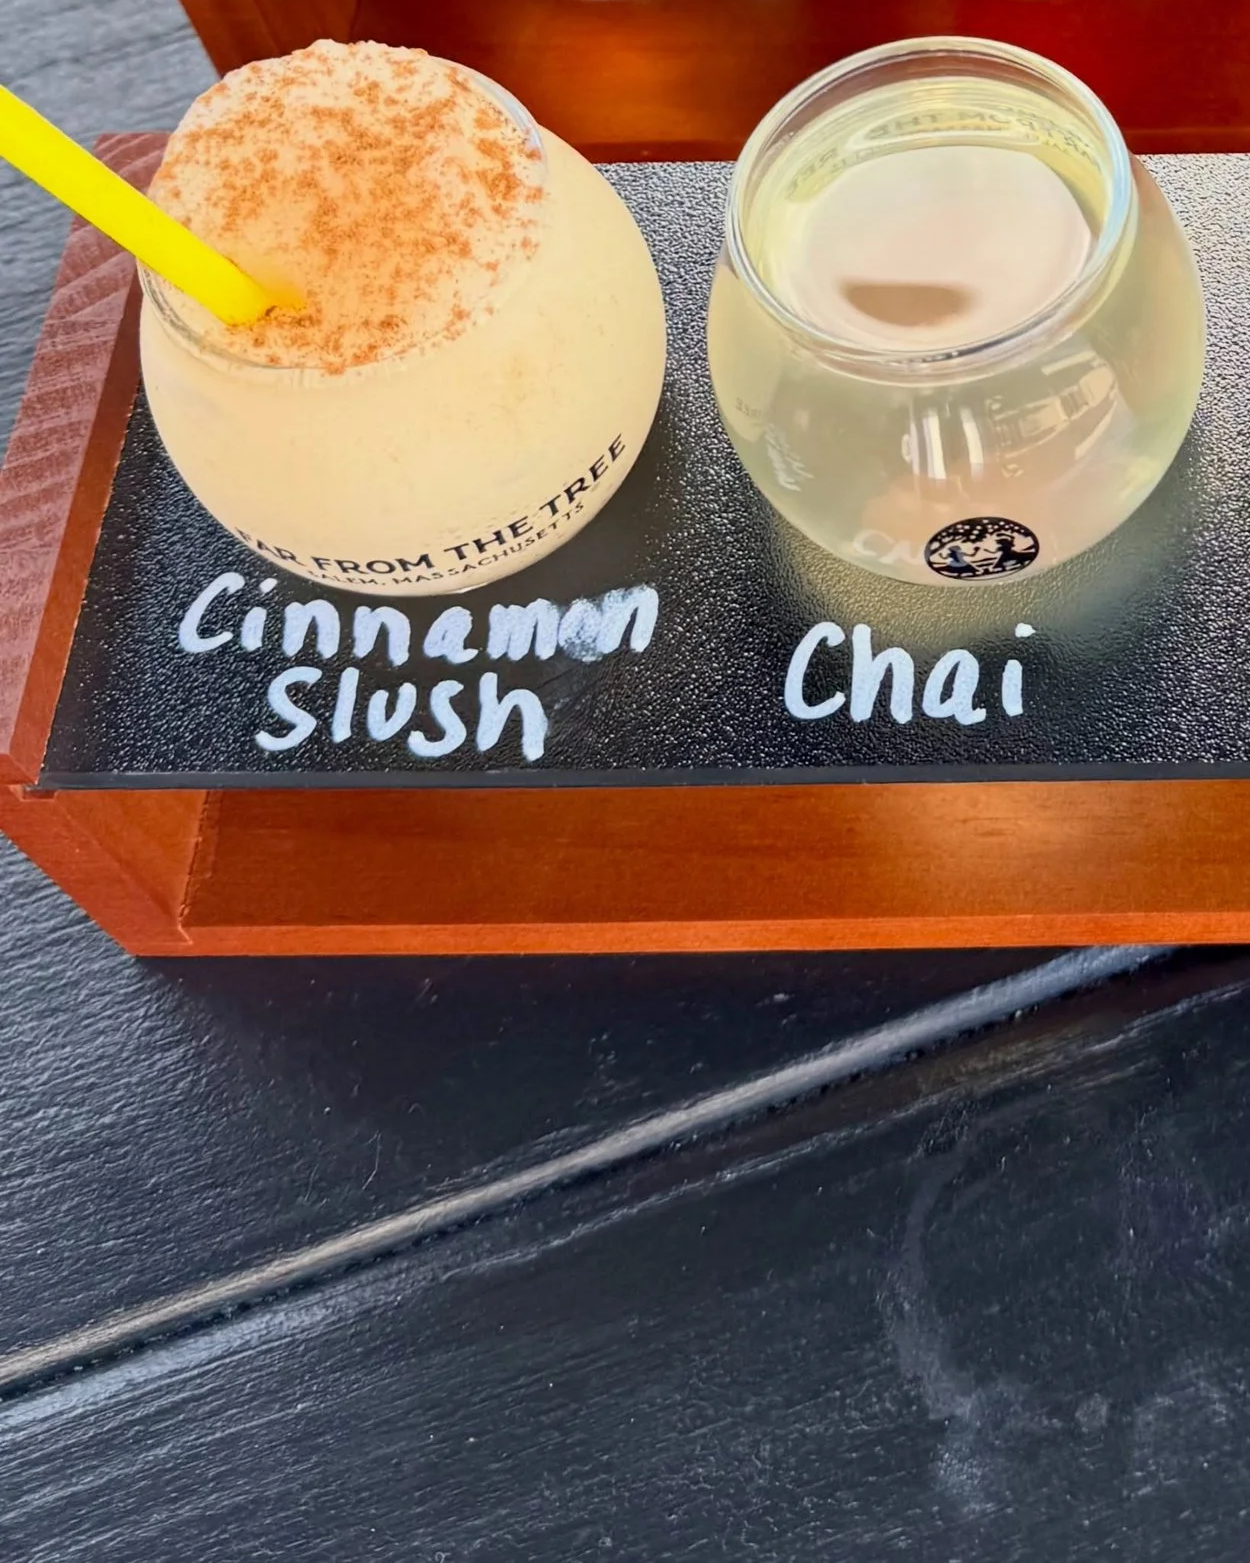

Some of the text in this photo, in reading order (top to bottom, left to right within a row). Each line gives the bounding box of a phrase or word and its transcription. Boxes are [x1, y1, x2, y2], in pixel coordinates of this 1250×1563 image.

[311, 553, 436, 575] FROM
[444, 516, 534, 561] THE
[539, 433, 627, 516] TREE
[392, 501, 585, 585] MASSACHUSETTS
[178, 571, 660, 666] Cinnamon
[255, 665, 549, 762] Slush
[782, 620, 1036, 726] Chai
